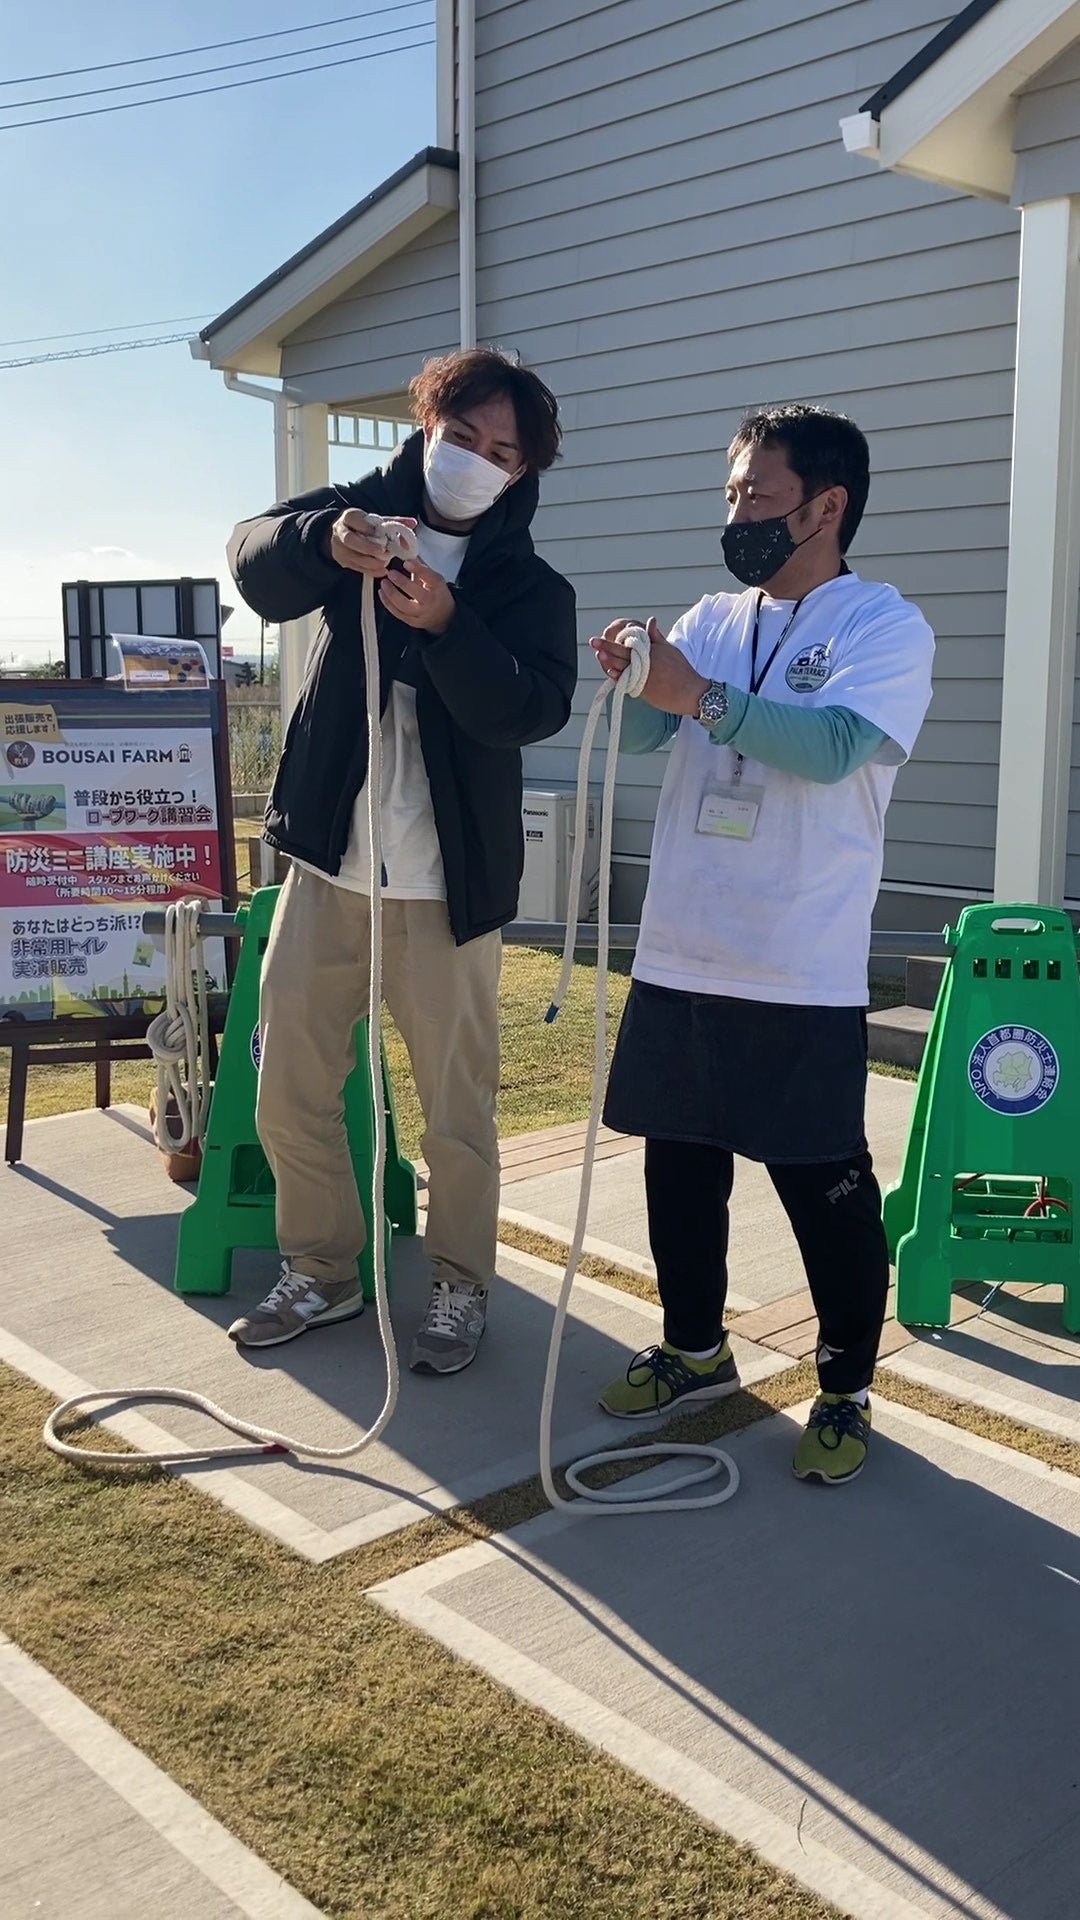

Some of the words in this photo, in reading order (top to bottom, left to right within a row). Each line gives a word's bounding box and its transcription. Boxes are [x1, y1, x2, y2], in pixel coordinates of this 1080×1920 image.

[805, 667, 827, 678] TERRACE
[4, 713, 53, 724] 出張販売で
[42, 750, 115, 764] BOUSAI
[122, 749, 173, 763] FARM
[87, 805, 213, 826] ロープワーク講習会
[523, 808, 548, 817] Panasonic
[11, 937, 108, 957] 非常用トイレ
[12, 956, 88, 979] 実演販売
[825, 1169, 860, 1204] FILA
